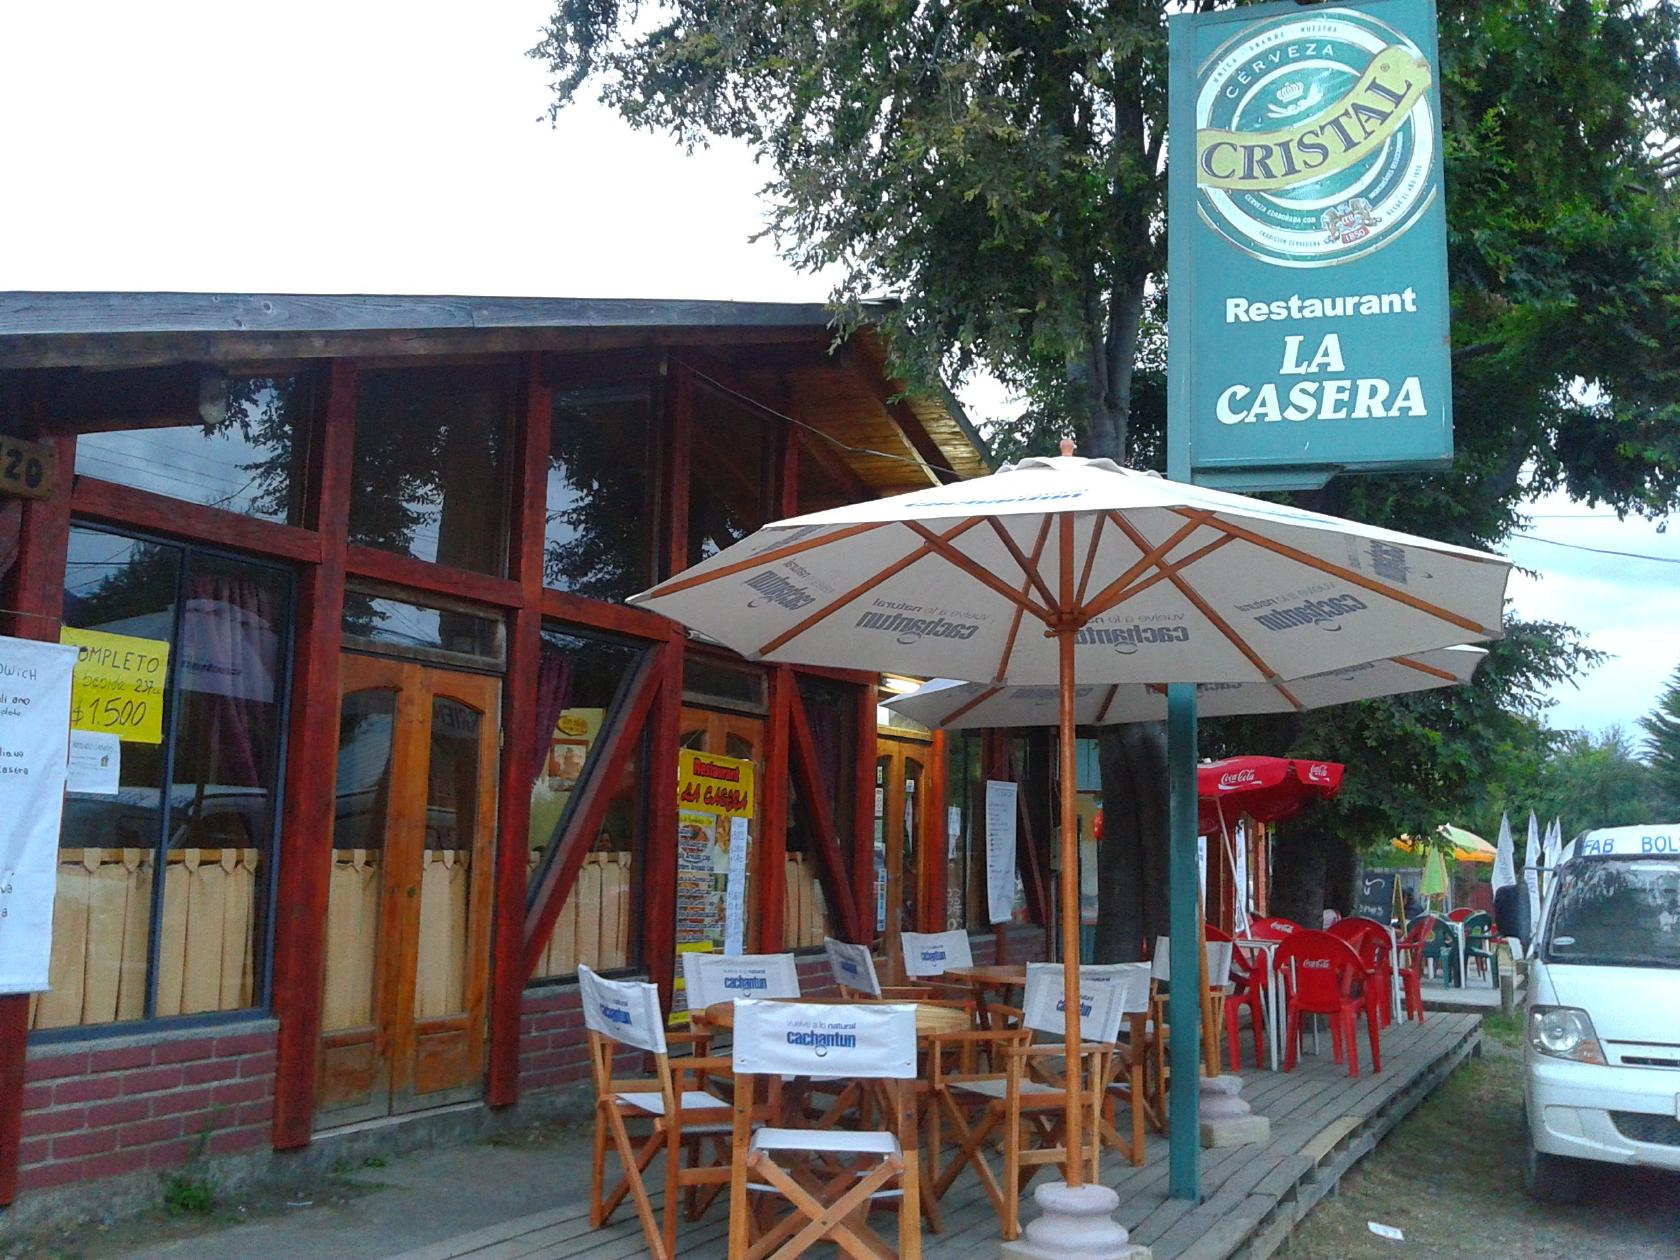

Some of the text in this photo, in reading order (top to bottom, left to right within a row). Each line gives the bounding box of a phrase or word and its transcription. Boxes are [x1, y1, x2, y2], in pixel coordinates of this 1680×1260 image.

[1226, 43, 1334, 98] CERVEZA
[1201, 77, 1412, 180] CRISTAL
[1345, 228, 1366, 242] 1850
[1226, 286, 1417, 323] Restaurant
[1279, 333, 1345, 375] LA
[1216, 376, 1428, 425] CASERA
[1584, 838, 1615, 854] FAB
[786, 1029, 857, 1048] cachantun
